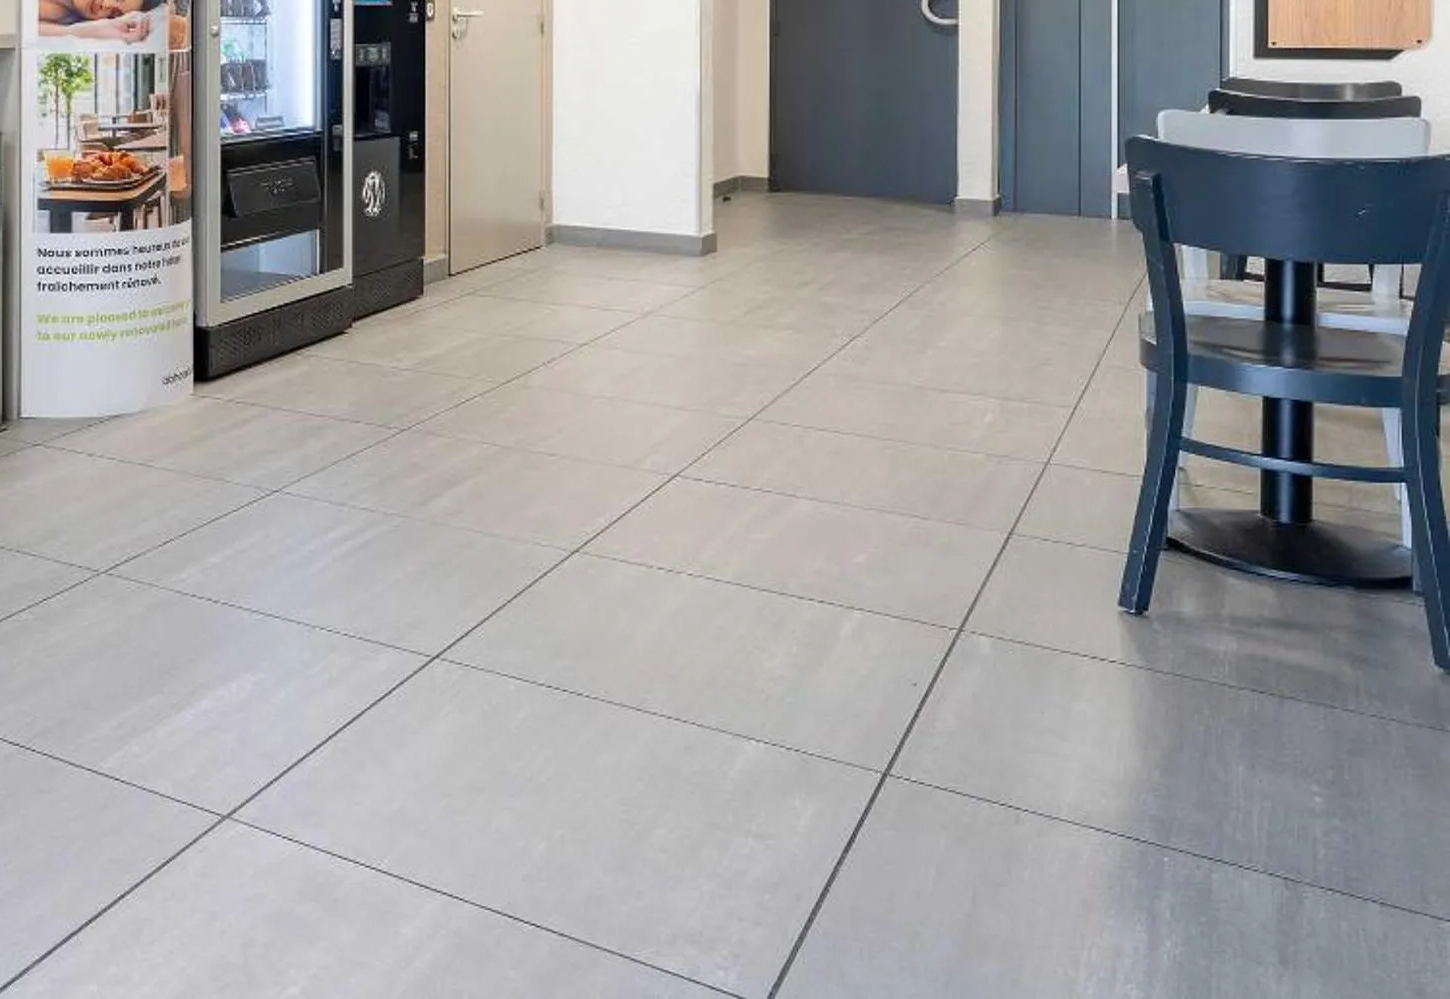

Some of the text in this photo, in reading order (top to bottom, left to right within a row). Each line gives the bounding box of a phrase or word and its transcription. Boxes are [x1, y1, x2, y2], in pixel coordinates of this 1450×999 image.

[37, 247, 71, 258] Nous
[74, 246, 130, 258] sommes
[37, 263, 100, 276] accueillir
[102, 261, 132, 274] dans
